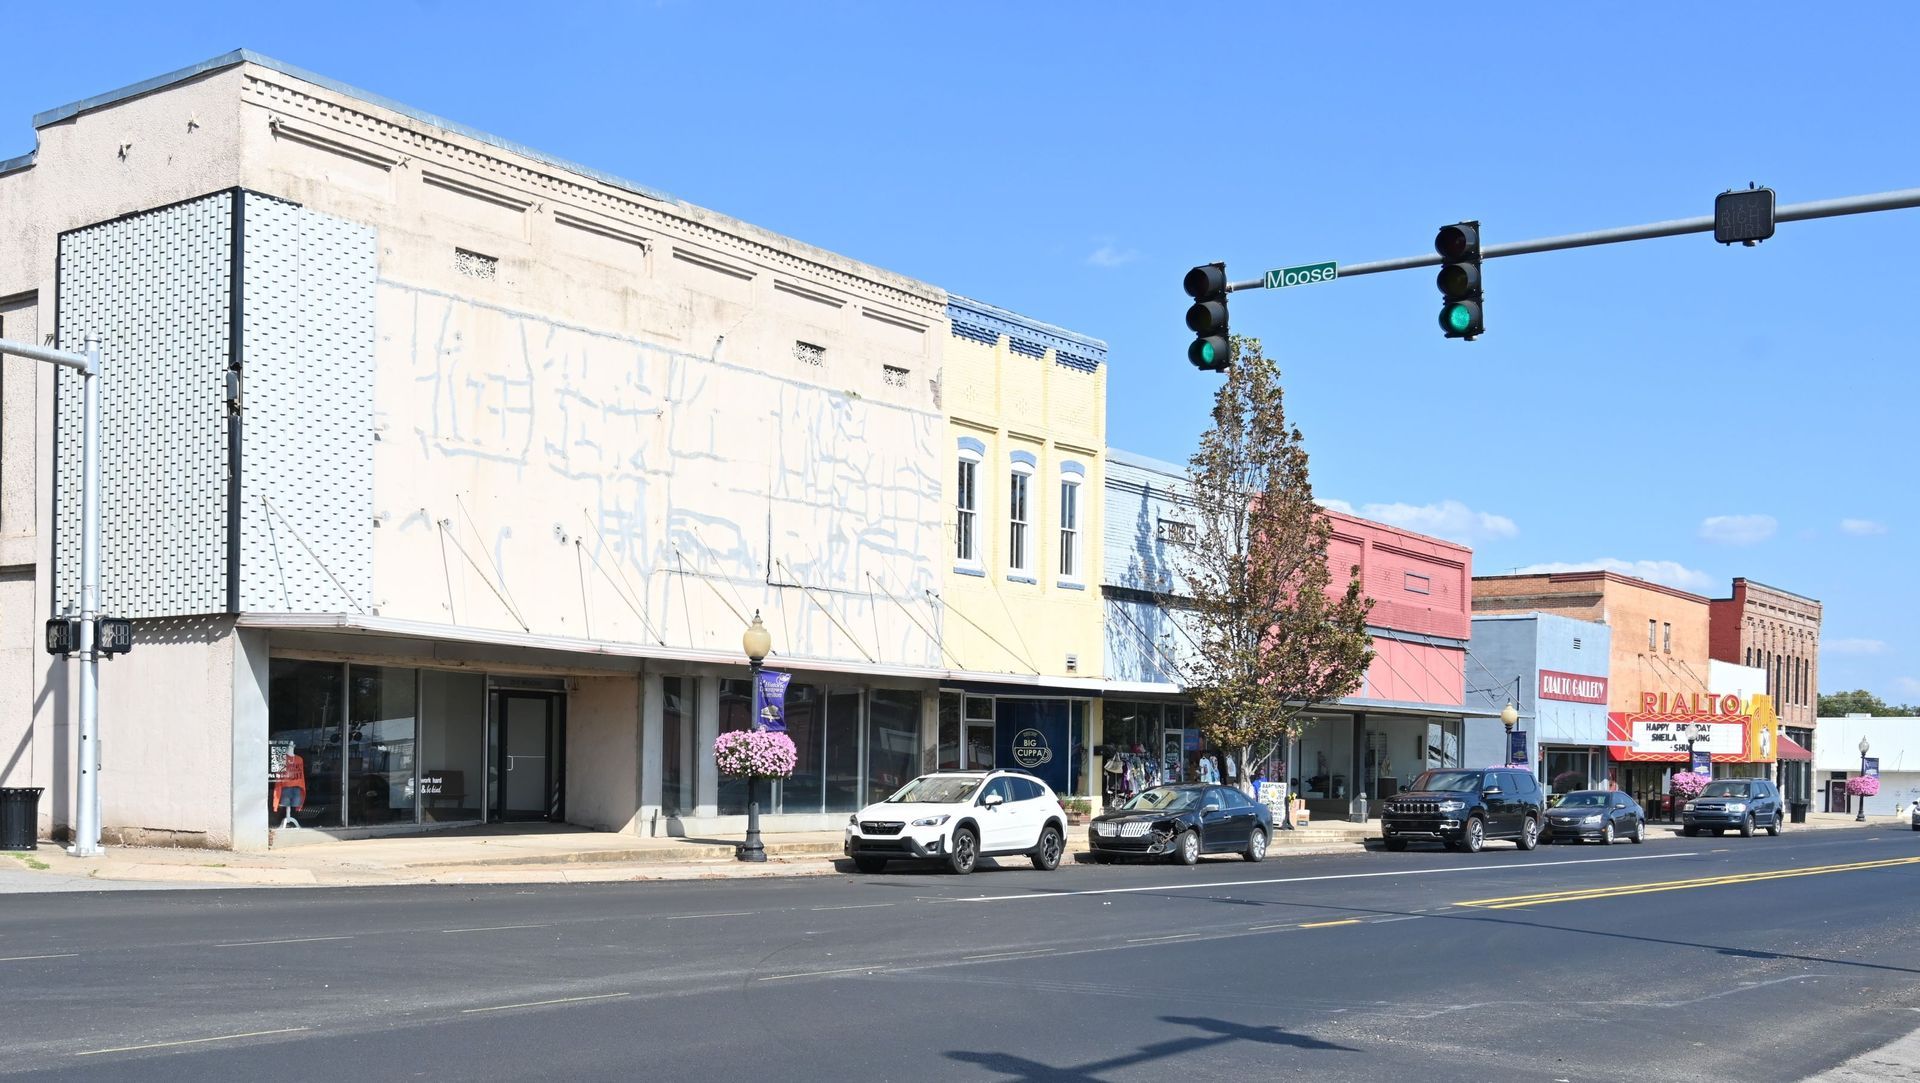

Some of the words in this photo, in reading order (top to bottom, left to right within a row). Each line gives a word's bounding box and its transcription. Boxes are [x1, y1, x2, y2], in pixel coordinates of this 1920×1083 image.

[1267, 267, 1335, 288] Moose
[1543, 675, 1571, 696] RIALTO
[1572, 679, 1604, 699] GALLERY
[1641, 691, 1740, 716] RIALTO
[1646, 723, 1669, 731] HAPPY
[1676, 723, 1711, 732] BIRDAY
[1651, 733, 1677, 741] SHEILA
[1023, 739, 1037, 747] BIG
[1017, 749, 1043, 757] CUPPA
